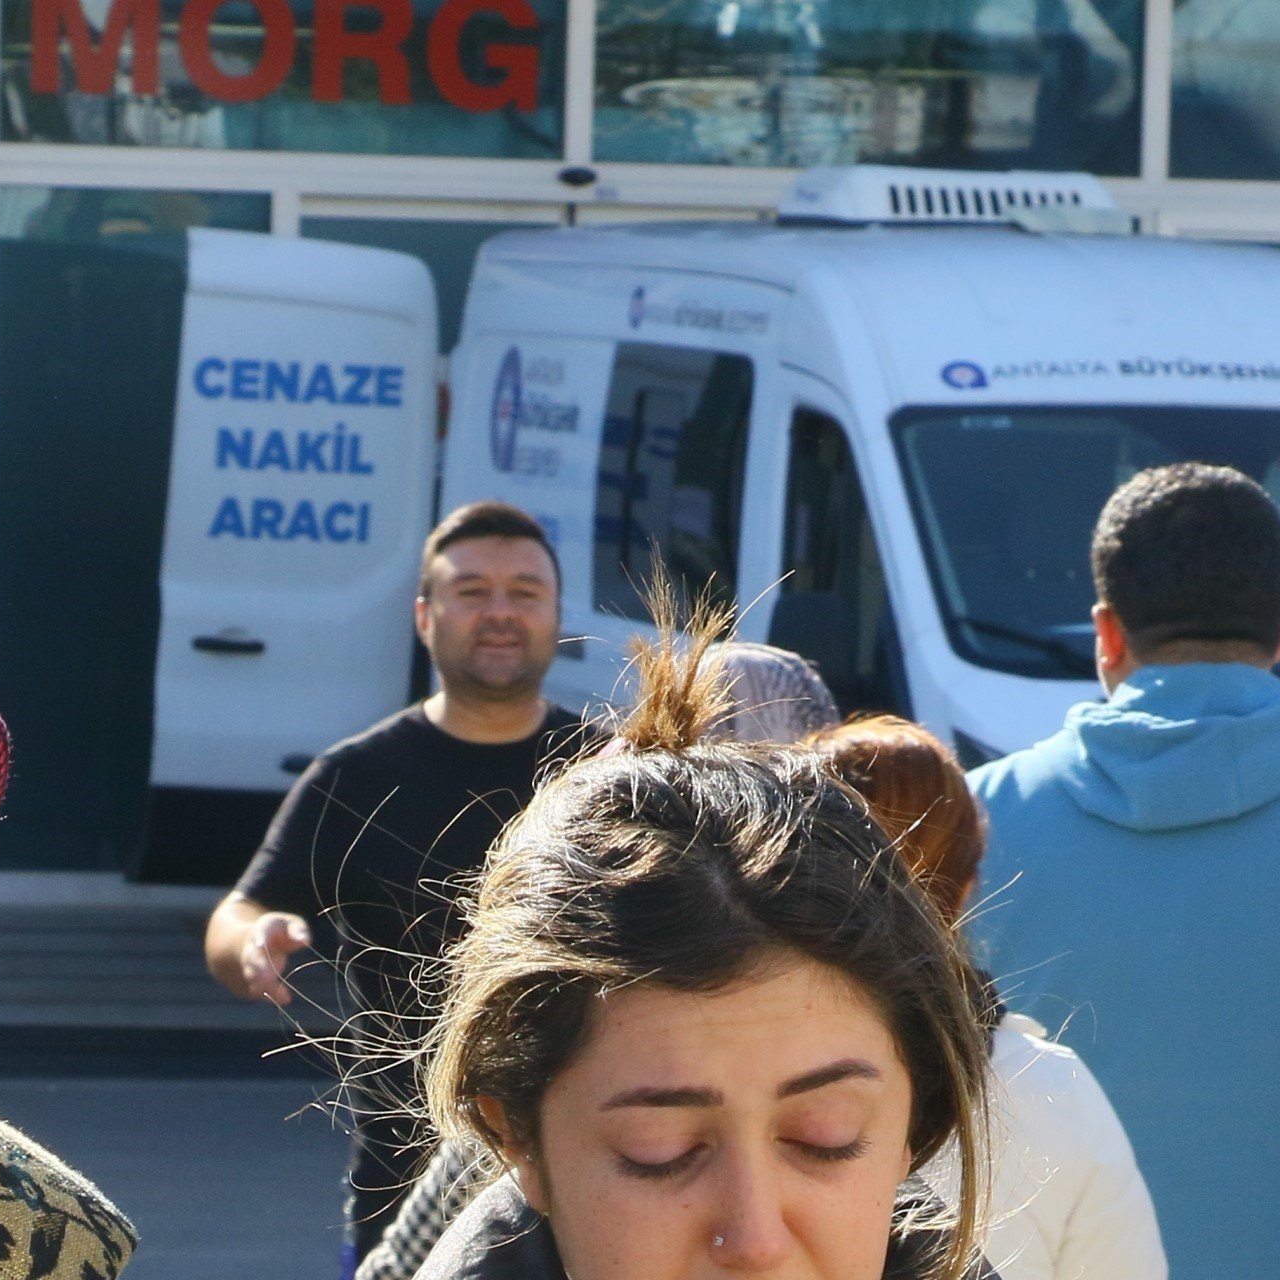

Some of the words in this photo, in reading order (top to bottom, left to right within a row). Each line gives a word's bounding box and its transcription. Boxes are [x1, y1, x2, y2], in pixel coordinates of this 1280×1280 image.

[29, 0, 540, 113] MORG
[193, 357, 405, 407] CENAZE
[992, 359, 1109, 378] ANTALYA
[216, 421, 374, 475] NAKİL
[208, 496, 371, 543] ARACI
